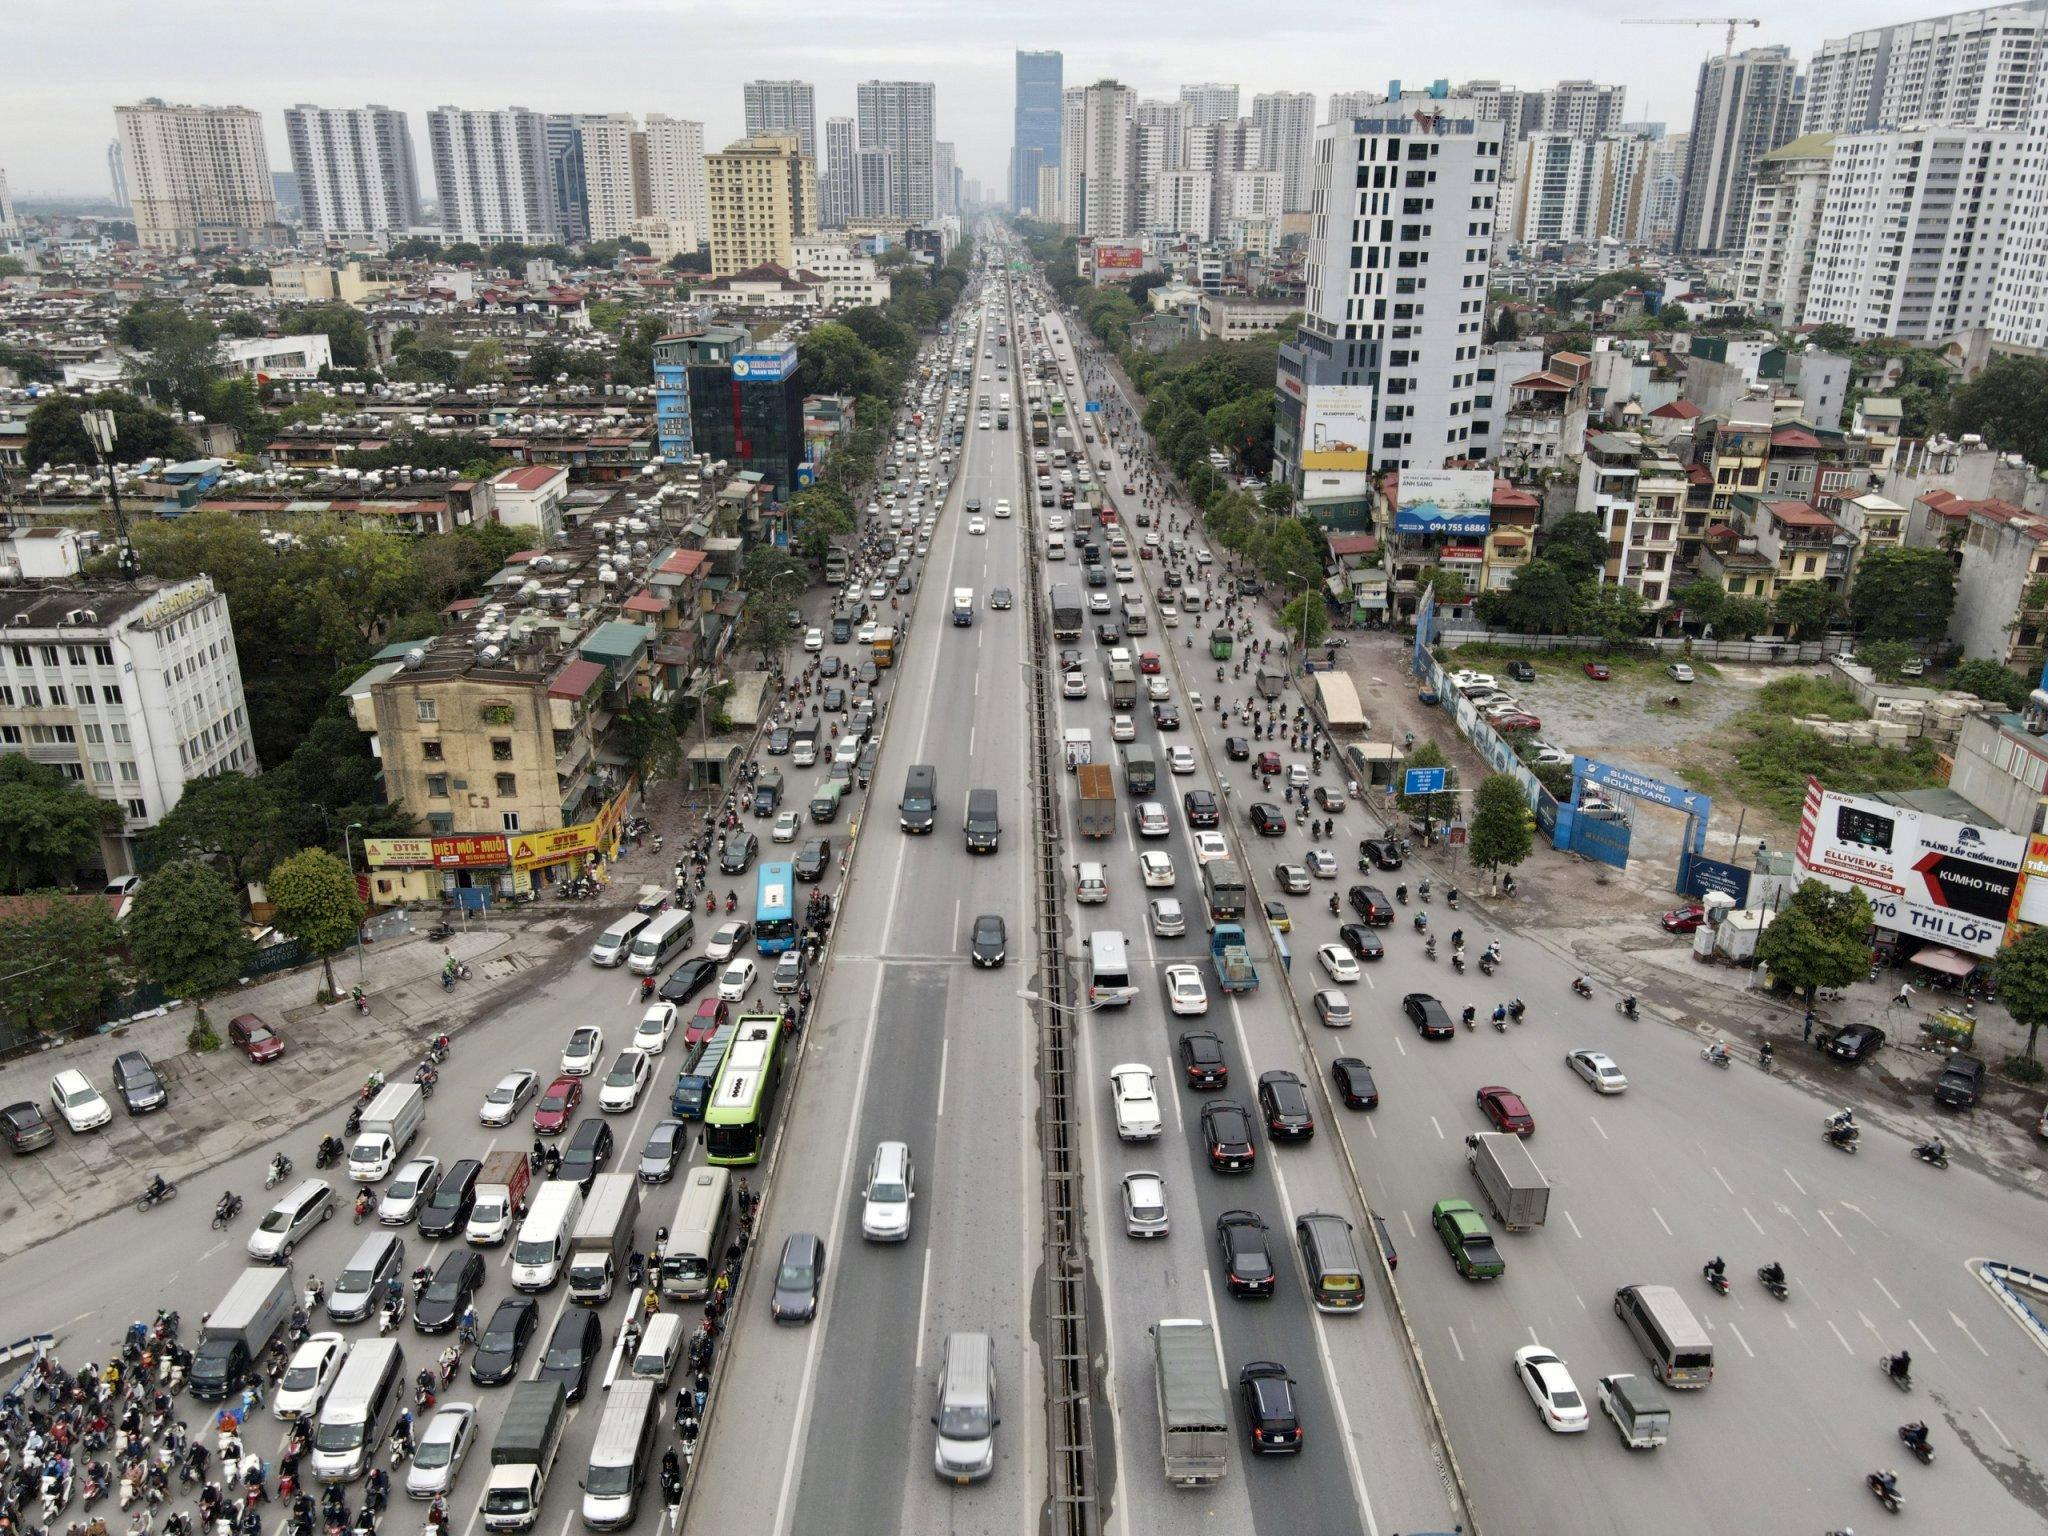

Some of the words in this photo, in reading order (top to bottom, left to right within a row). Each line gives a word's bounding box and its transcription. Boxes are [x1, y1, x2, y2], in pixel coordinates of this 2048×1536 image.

[1429, 523, 1446, 531] 094
[1448, 523, 1462, 531] 755
[1464, 524, 1486, 532] 6886
[1603, 775, 1671, 803] BOULEVARD
[1610, 770, 1666, 793] SUNSHINE
[467, 793, 489, 808] C3
[1825, 793, 1854, 804] ICAR.VN
[393, 843, 419, 851] DTH
[433, 841, 454, 856] DIỆT
[456, 838, 475, 854] MỐI
[1920, 839, 1948, 852] TRÁNG
[1950, 846, 1965, 856] LỐP
[1967, 851, 1995, 863] CHỐNG
[1825, 850, 1877, 868] ELLIVIEW
[1880, 864, 1894, 873] S4
[1940, 870, 1982, 888] KUMHO
[1985, 882, 2010, 896] TIRE
[1910, 910, 1943, 932] THI
[1947, 922, 1992, 943] LỐP
